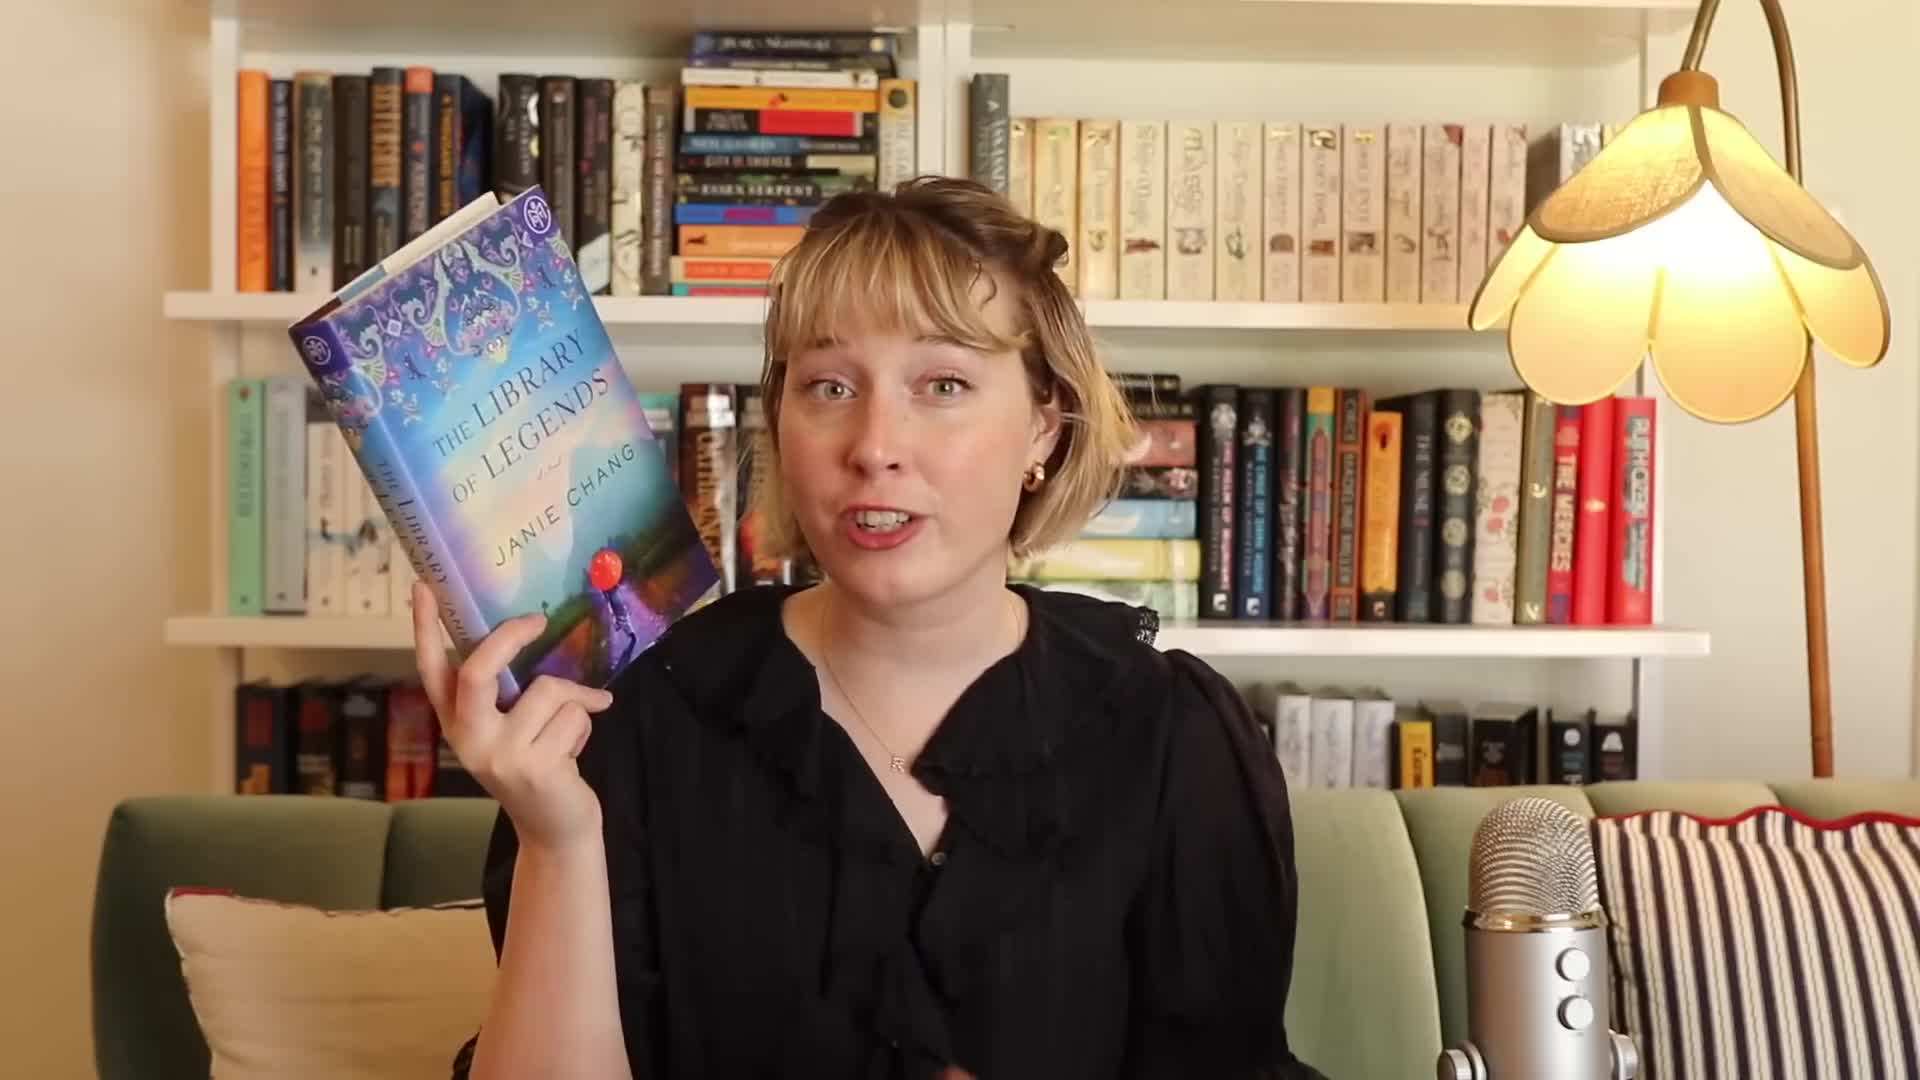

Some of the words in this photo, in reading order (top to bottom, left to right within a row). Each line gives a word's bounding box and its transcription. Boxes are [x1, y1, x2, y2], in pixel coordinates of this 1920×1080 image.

[750, 184, 814, 196] SERPENT
[432, 419, 475, 458] THE
[471, 327, 586, 429] LIBRARY
[451, 472, 480, 504] OF
[480, 367, 609, 480] LEGENDS
[1415, 433, 1431, 462] THE
[1556, 453, 1577, 489] THE
[495, 504, 561, 567] JANIE
[565, 443, 635, 507] CHANG
[1341, 453, 1357, 530] MADELINE
[1413, 469, 1430, 514] MUSE
[397, 498, 449, 585] LIBRARY
[1552, 493, 1576, 573] MERCIES
